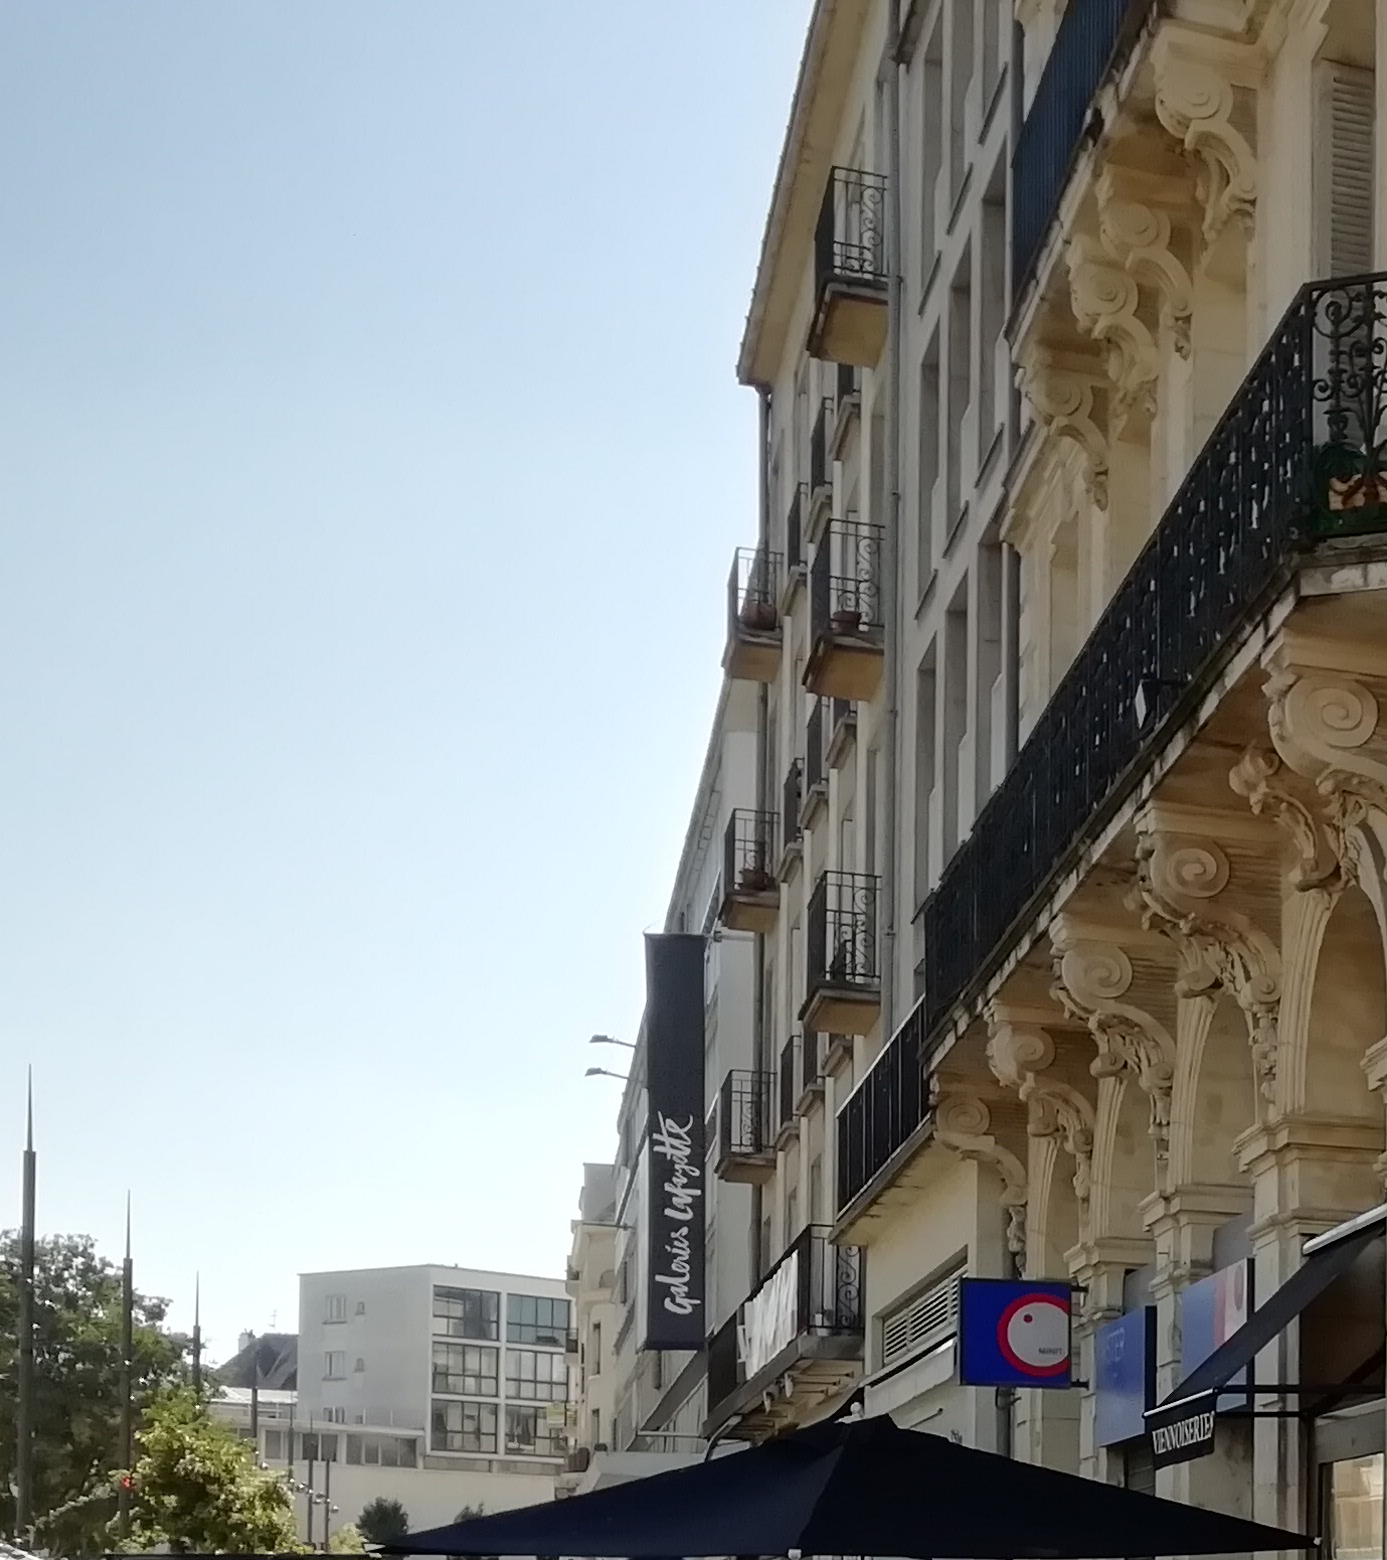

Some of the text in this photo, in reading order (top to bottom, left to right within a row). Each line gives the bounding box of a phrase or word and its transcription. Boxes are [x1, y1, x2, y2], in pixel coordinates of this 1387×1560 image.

[652, 1111, 702, 1315] Galeries Lafayette
[1152, 1410, 1216, 1455] VIENNOISERIES
